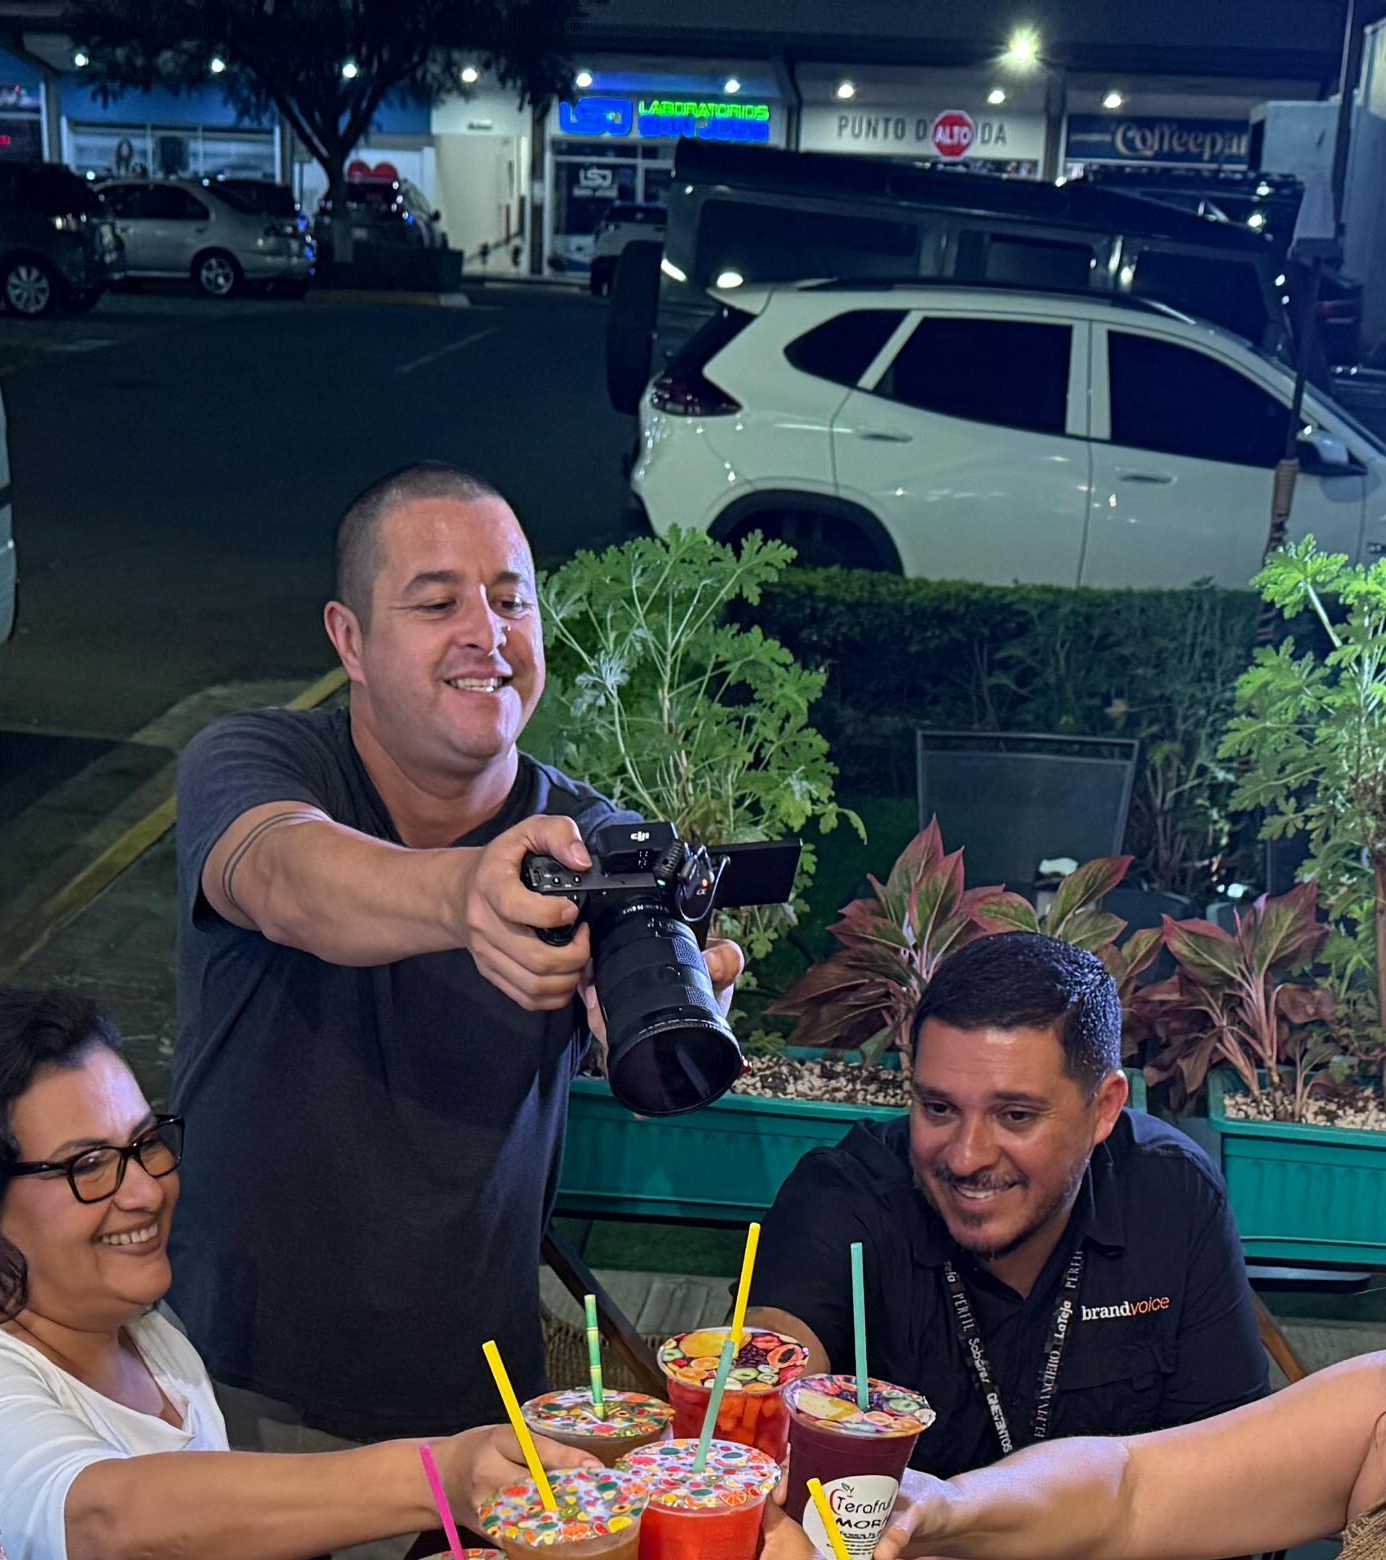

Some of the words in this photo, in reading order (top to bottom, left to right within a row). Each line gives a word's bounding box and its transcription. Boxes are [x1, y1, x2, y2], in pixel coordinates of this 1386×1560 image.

[639, 100, 770, 121] LABORATORIOS
[837, 115, 907, 140] PUNTO
[935, 125, 973, 144] ALTO
[630, 831, 650, 842] dji
[952, 1293, 975, 1332] PERFIL
[1081, 1296, 1170, 1321] brandvoice
[1037, 1350, 1061, 1421] FINANCIERO
[1054, 1300, 1073, 1340] LaTeja
[837, 1495, 894, 1514] Terafru
